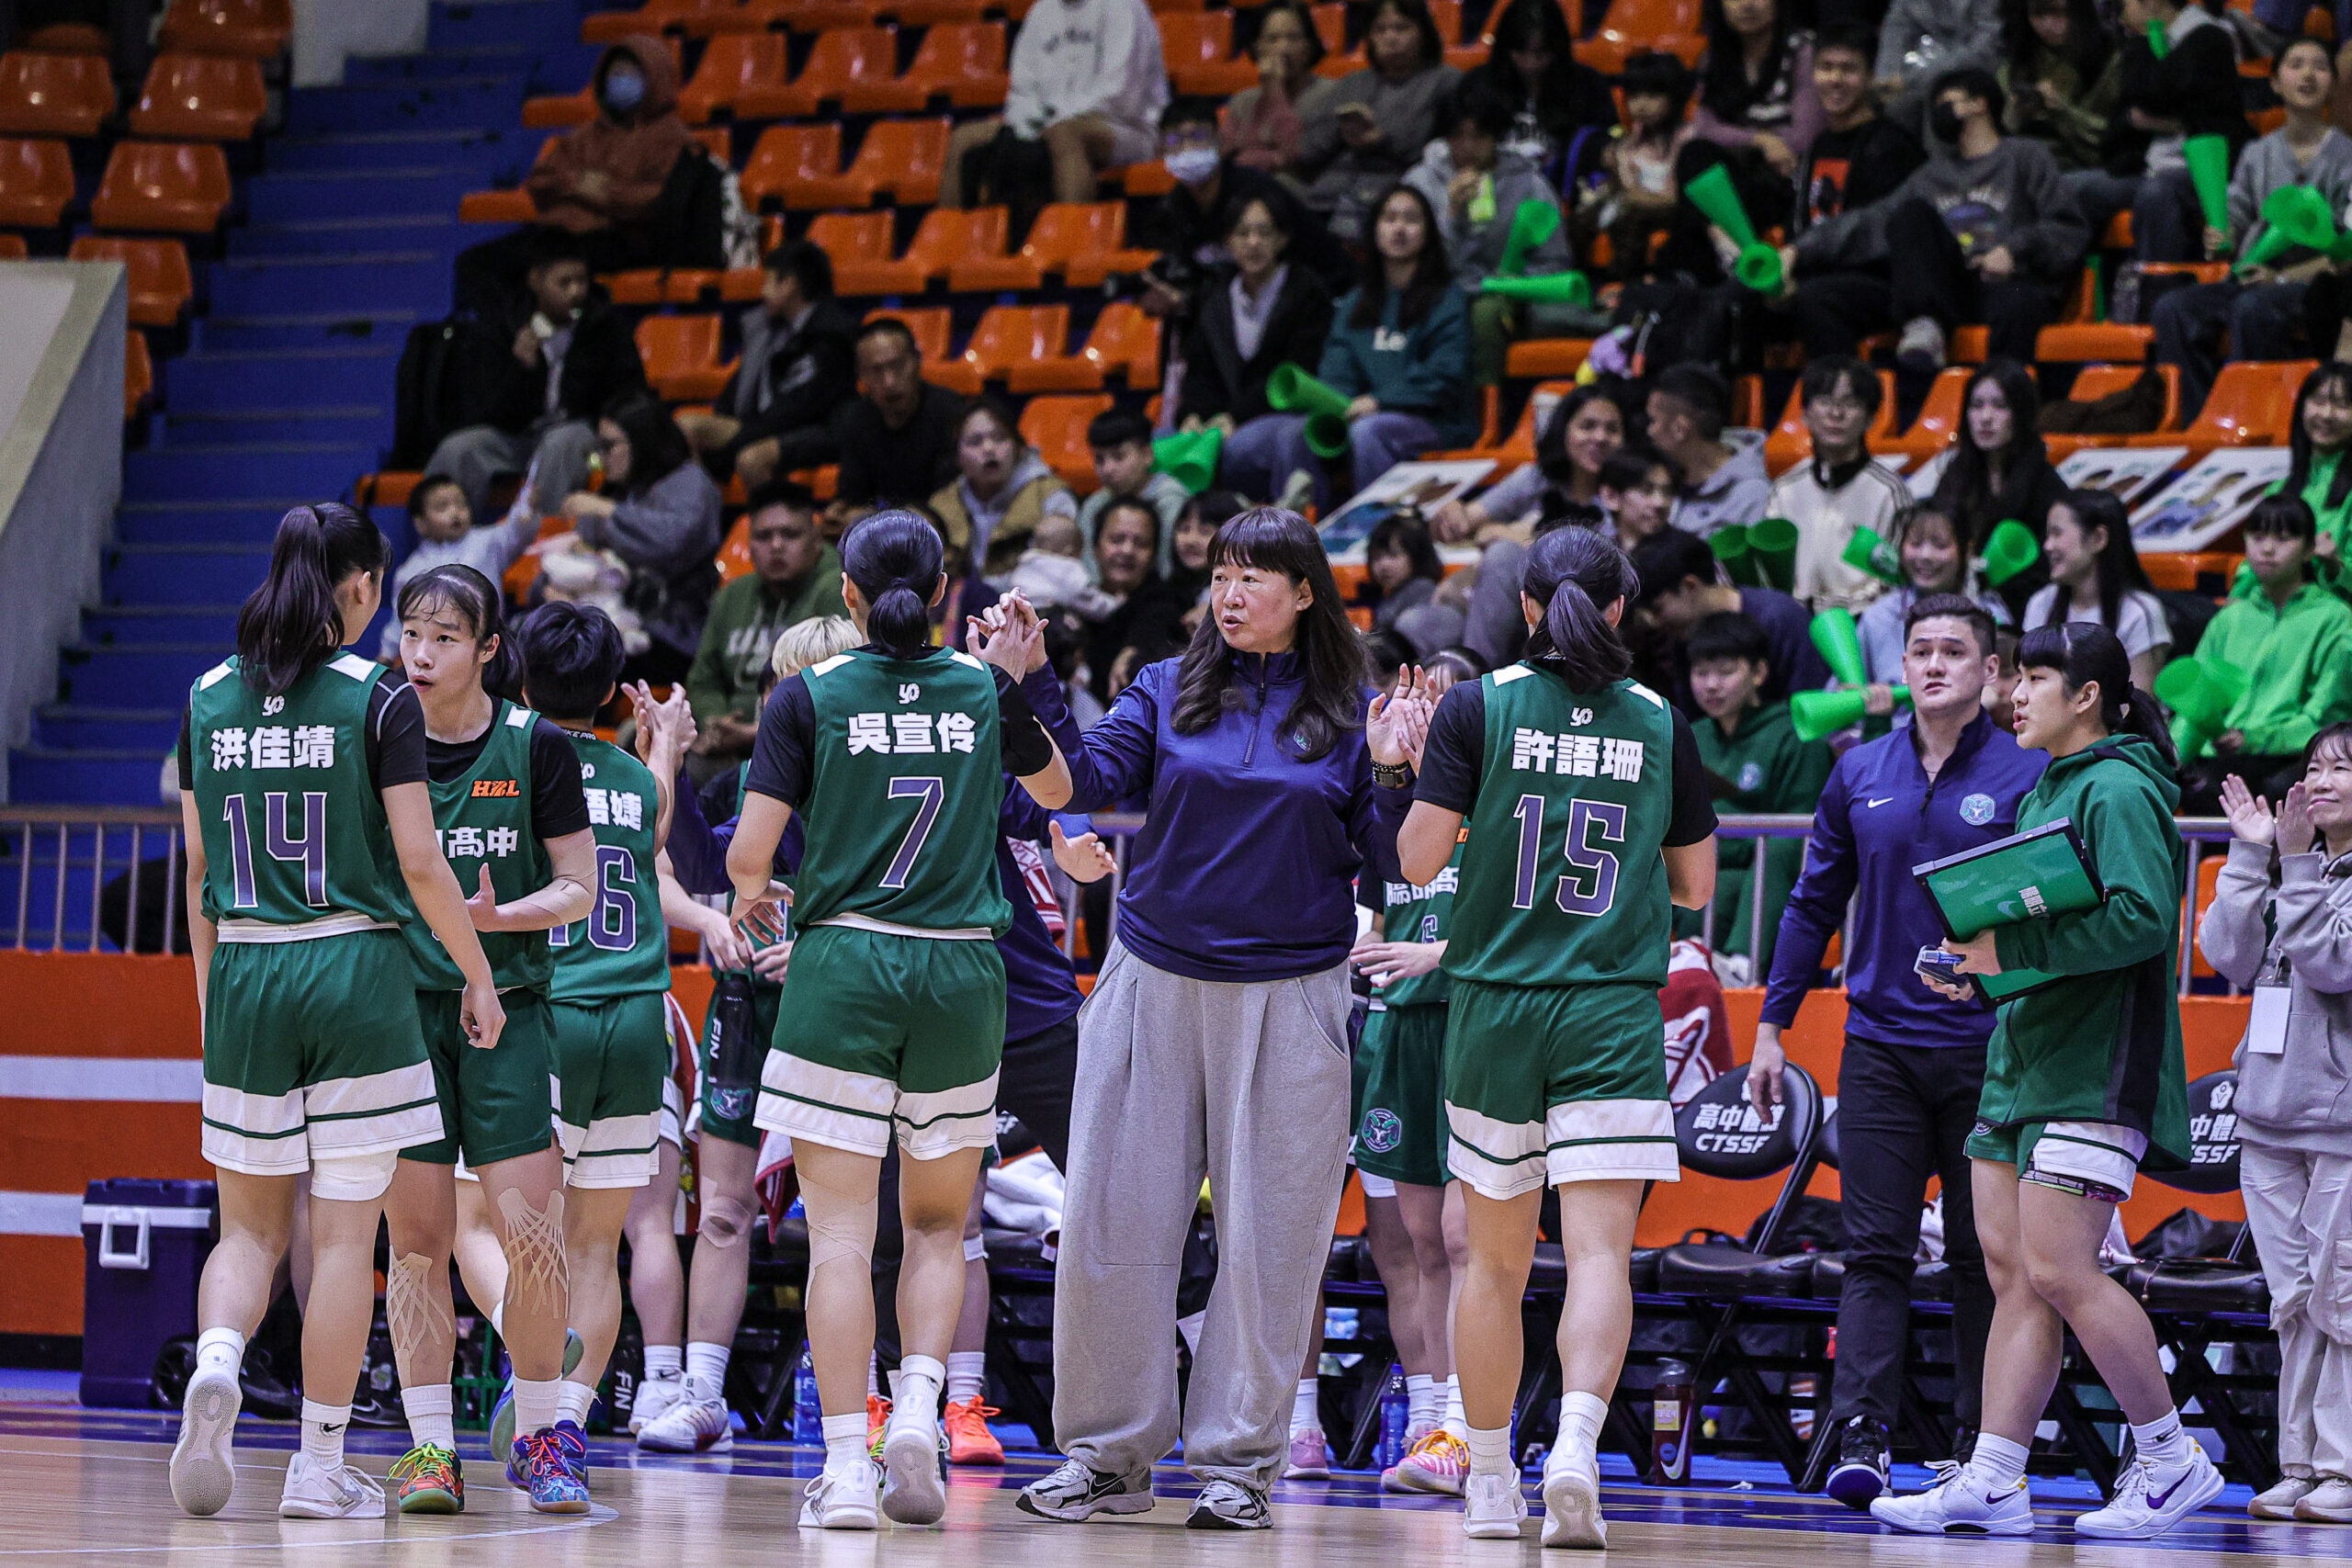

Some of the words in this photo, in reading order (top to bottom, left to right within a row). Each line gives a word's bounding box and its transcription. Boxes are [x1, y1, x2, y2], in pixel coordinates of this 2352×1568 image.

[210, 725, 335, 772] 洪佳靖
[580, 732, 596, 740] PRO
[847, 712, 977, 756] 吳宣伶
[1512, 727, 1644, 783] 許語珊
[222, 792, 330, 908] 14
[435, 826, 519, 859] 高中
[877, 776, 944, 889] 7
[1511, 794, 1627, 918] 15
[548, 844, 637, 952] 6
[709, 1017, 722, 1059] FIN
[1695, 1134, 1771, 1154] CTSSF
[614, 1370, 632, 1411] FIN
